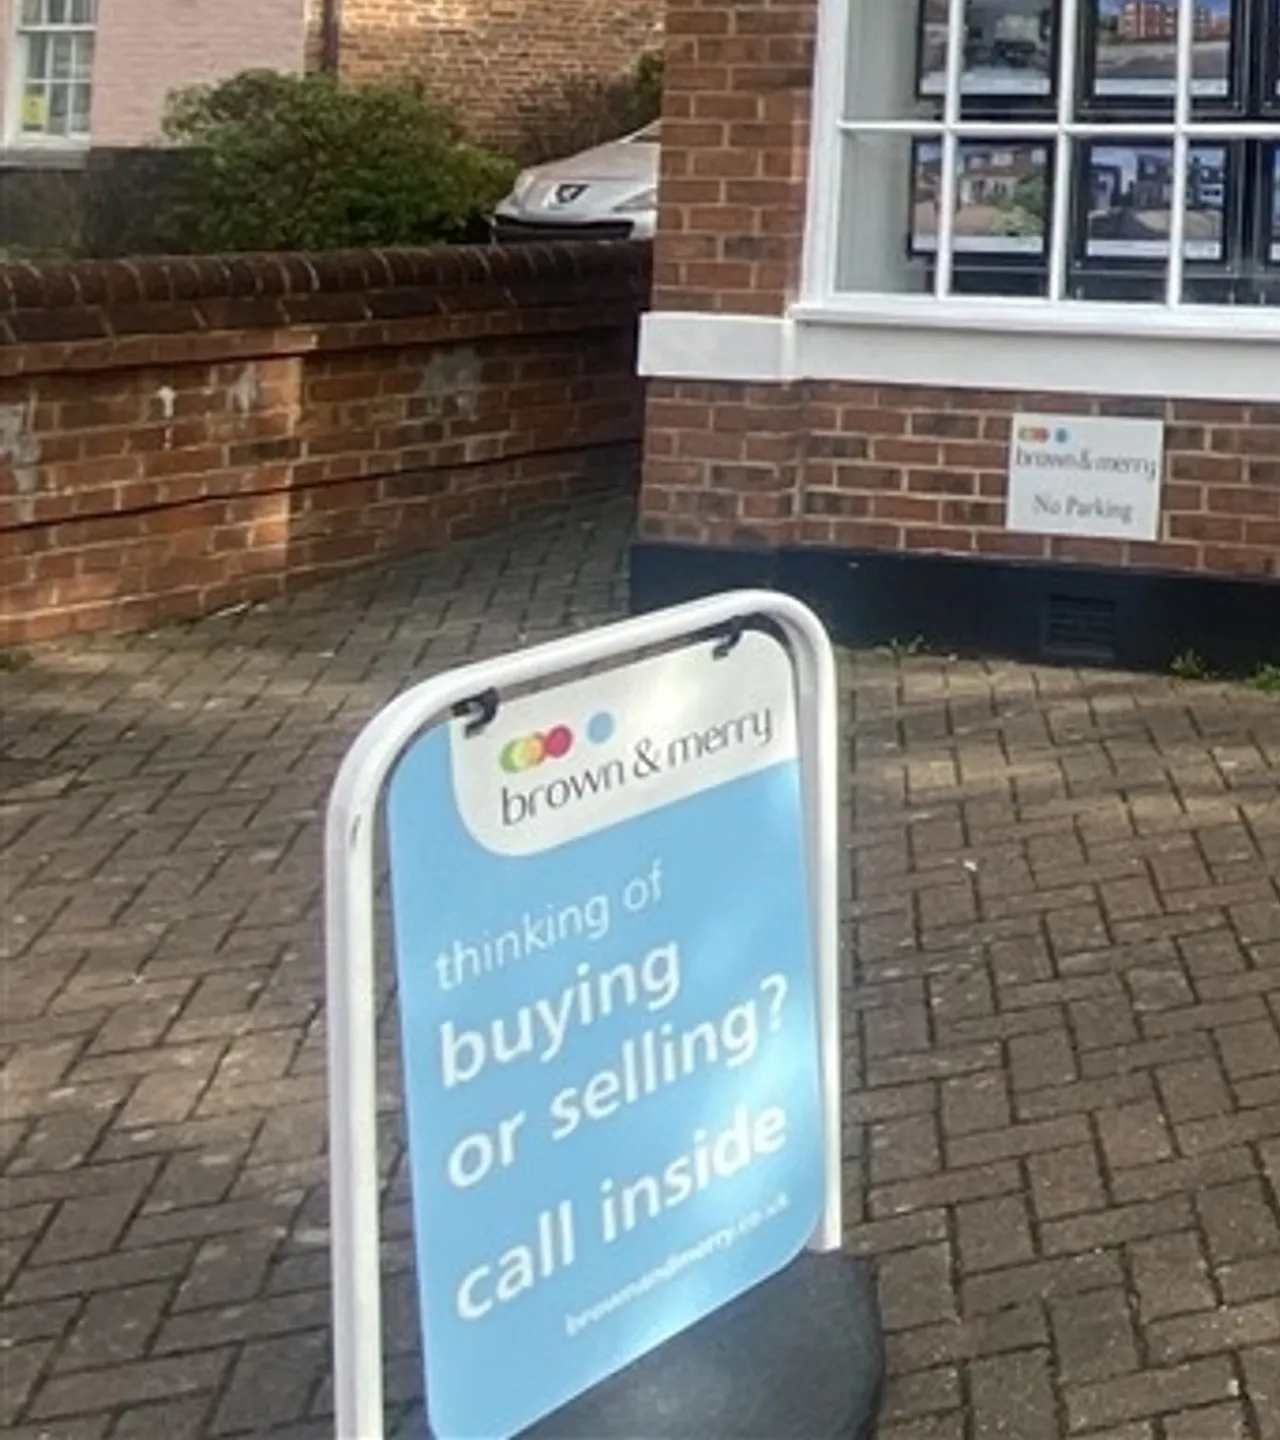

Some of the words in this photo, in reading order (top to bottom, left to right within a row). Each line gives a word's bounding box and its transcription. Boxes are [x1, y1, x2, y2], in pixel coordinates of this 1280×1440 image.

[1016, 445, 1078, 471] brown
[1093, 454, 1157, 483] merry
[1033, 493, 1062, 515] No
[1065, 496, 1133, 524] Parking
[499, 758, 627, 827] brown
[632, 735, 663, 776] &
[665, 703, 775, 773] merry
[434, 893, 610, 992] thinking
[622, 856, 664, 912] of
[439, 940, 681, 1088] buying
[447, 1109, 527, 1189] or
[549, 971, 790, 1138] selling?
[455, 1195, 576, 1322] call
[600, 1100, 789, 1243] inside
